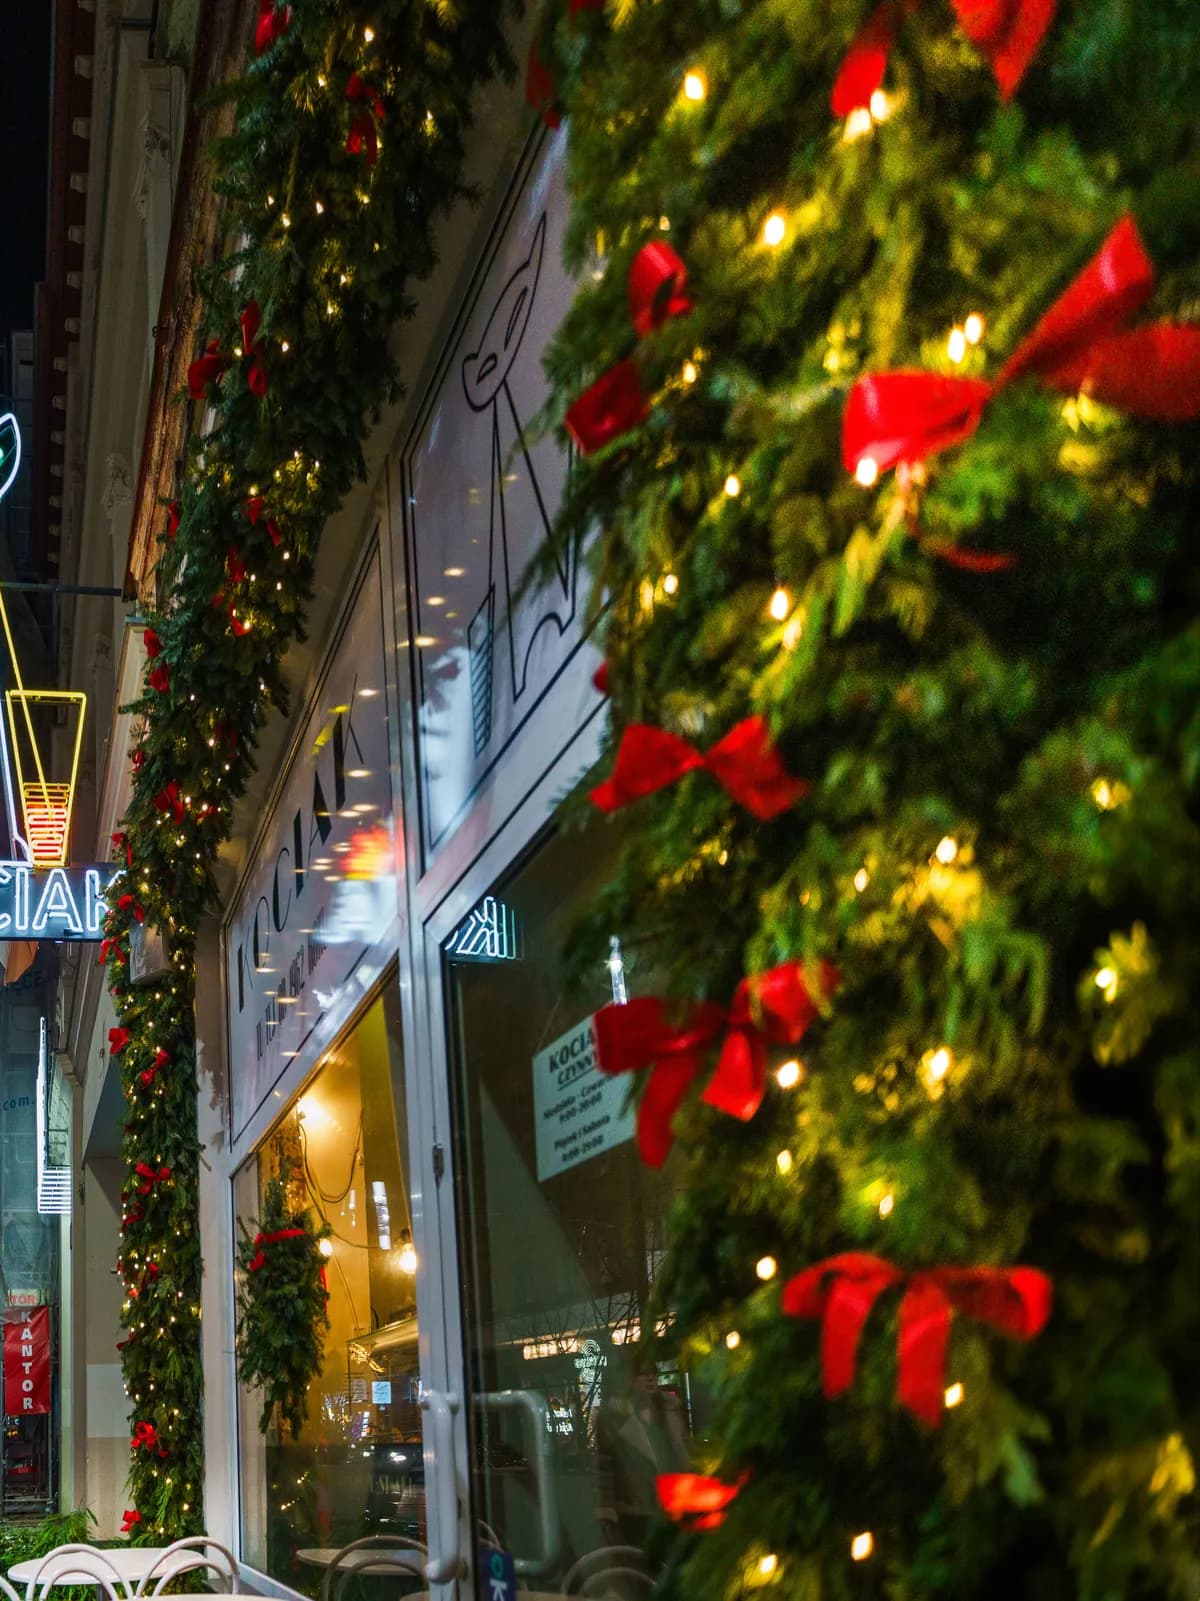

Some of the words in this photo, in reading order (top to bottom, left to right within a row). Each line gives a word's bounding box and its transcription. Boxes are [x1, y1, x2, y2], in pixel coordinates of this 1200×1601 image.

[548, 1028, 594, 1073] KOCIA
[557, 1054, 596, 1085] CZYNN
[21, 1311, 34, 1410] KANTOR
